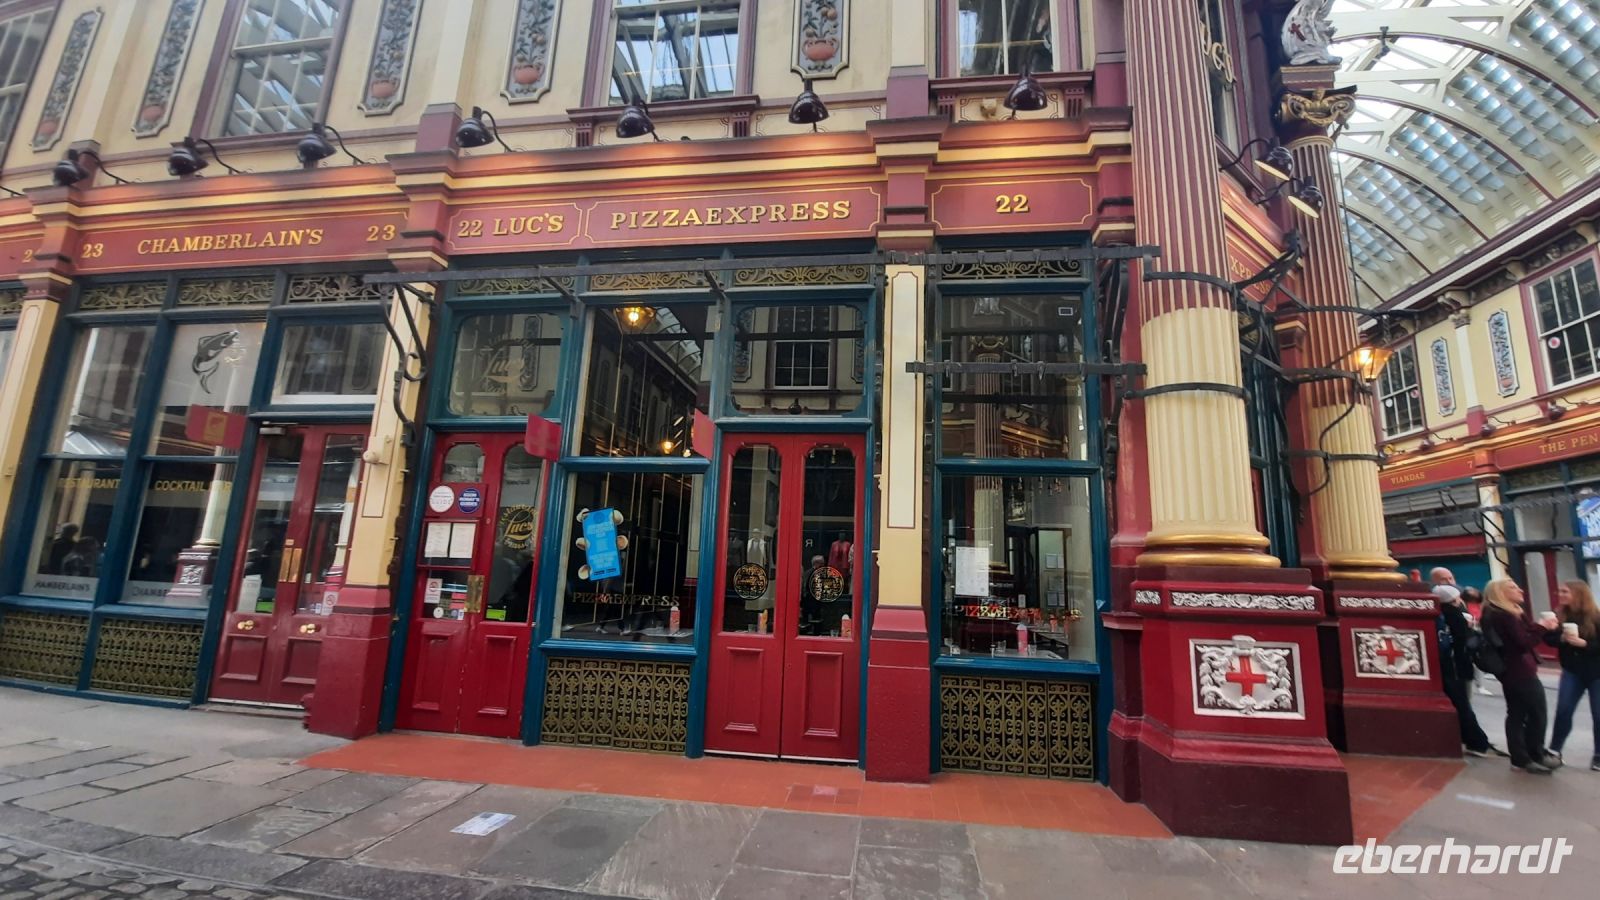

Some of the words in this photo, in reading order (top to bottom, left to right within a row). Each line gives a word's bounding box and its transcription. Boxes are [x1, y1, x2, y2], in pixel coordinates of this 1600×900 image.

[995, 194, 1029, 213] 22
[610, 200, 851, 229] PIZZAEXPRESS
[457, 219, 483, 237] 22
[493, 212, 564, 236] LUC'S
[137, 229, 323, 255] CHAMBERLAIN'S
[366, 225, 396, 242] 23
[81, 243, 104, 259] 23
[1539, 440, 1567, 455] THE
[154, 480, 207, 492] COCKTAIL
[1391, 472, 1425, 485] VIANDAS
